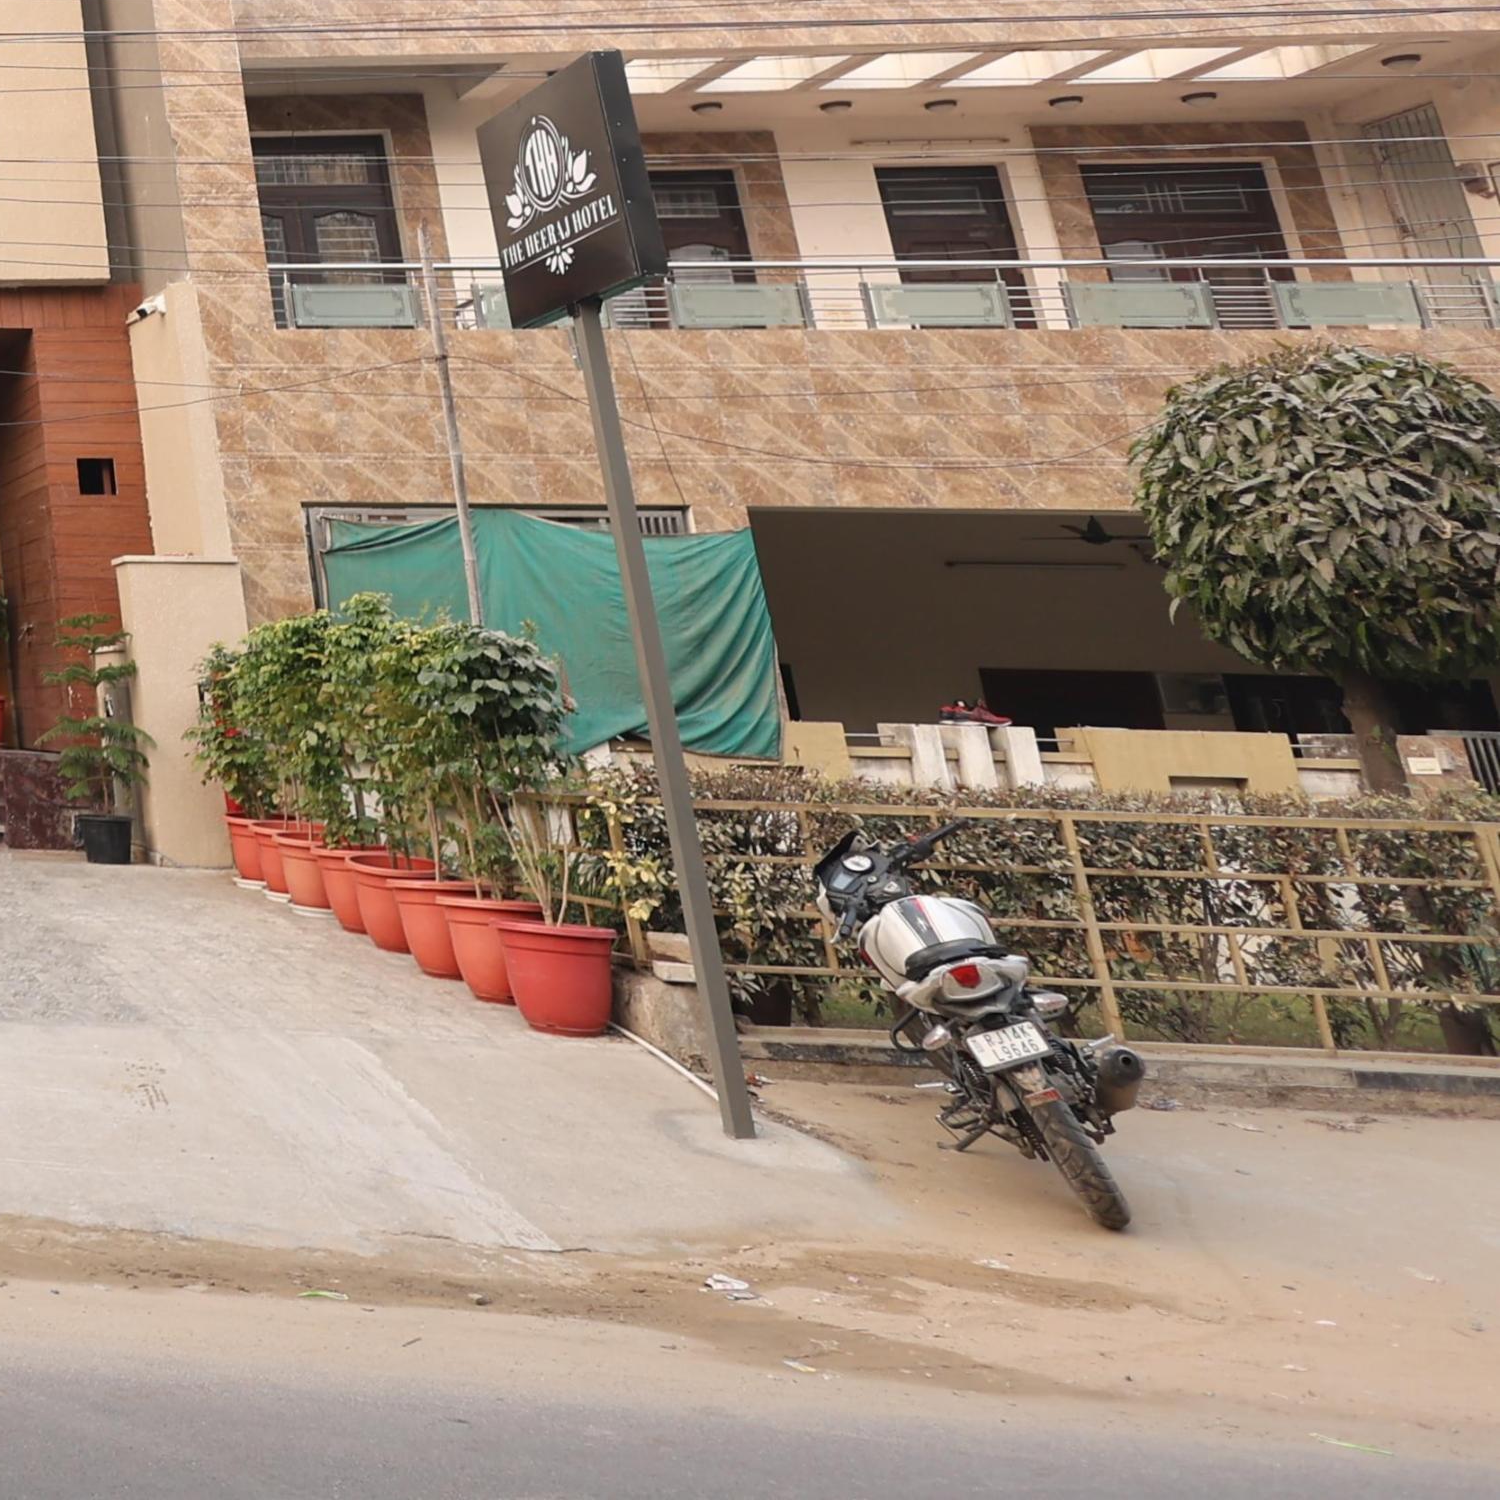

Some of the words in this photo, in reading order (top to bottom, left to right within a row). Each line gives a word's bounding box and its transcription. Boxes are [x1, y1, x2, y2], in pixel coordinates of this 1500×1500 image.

[502, 243, 525, 269] THE
[525, 216, 571, 257] HEERAJ
[572, 194, 617, 235] HOTEL
